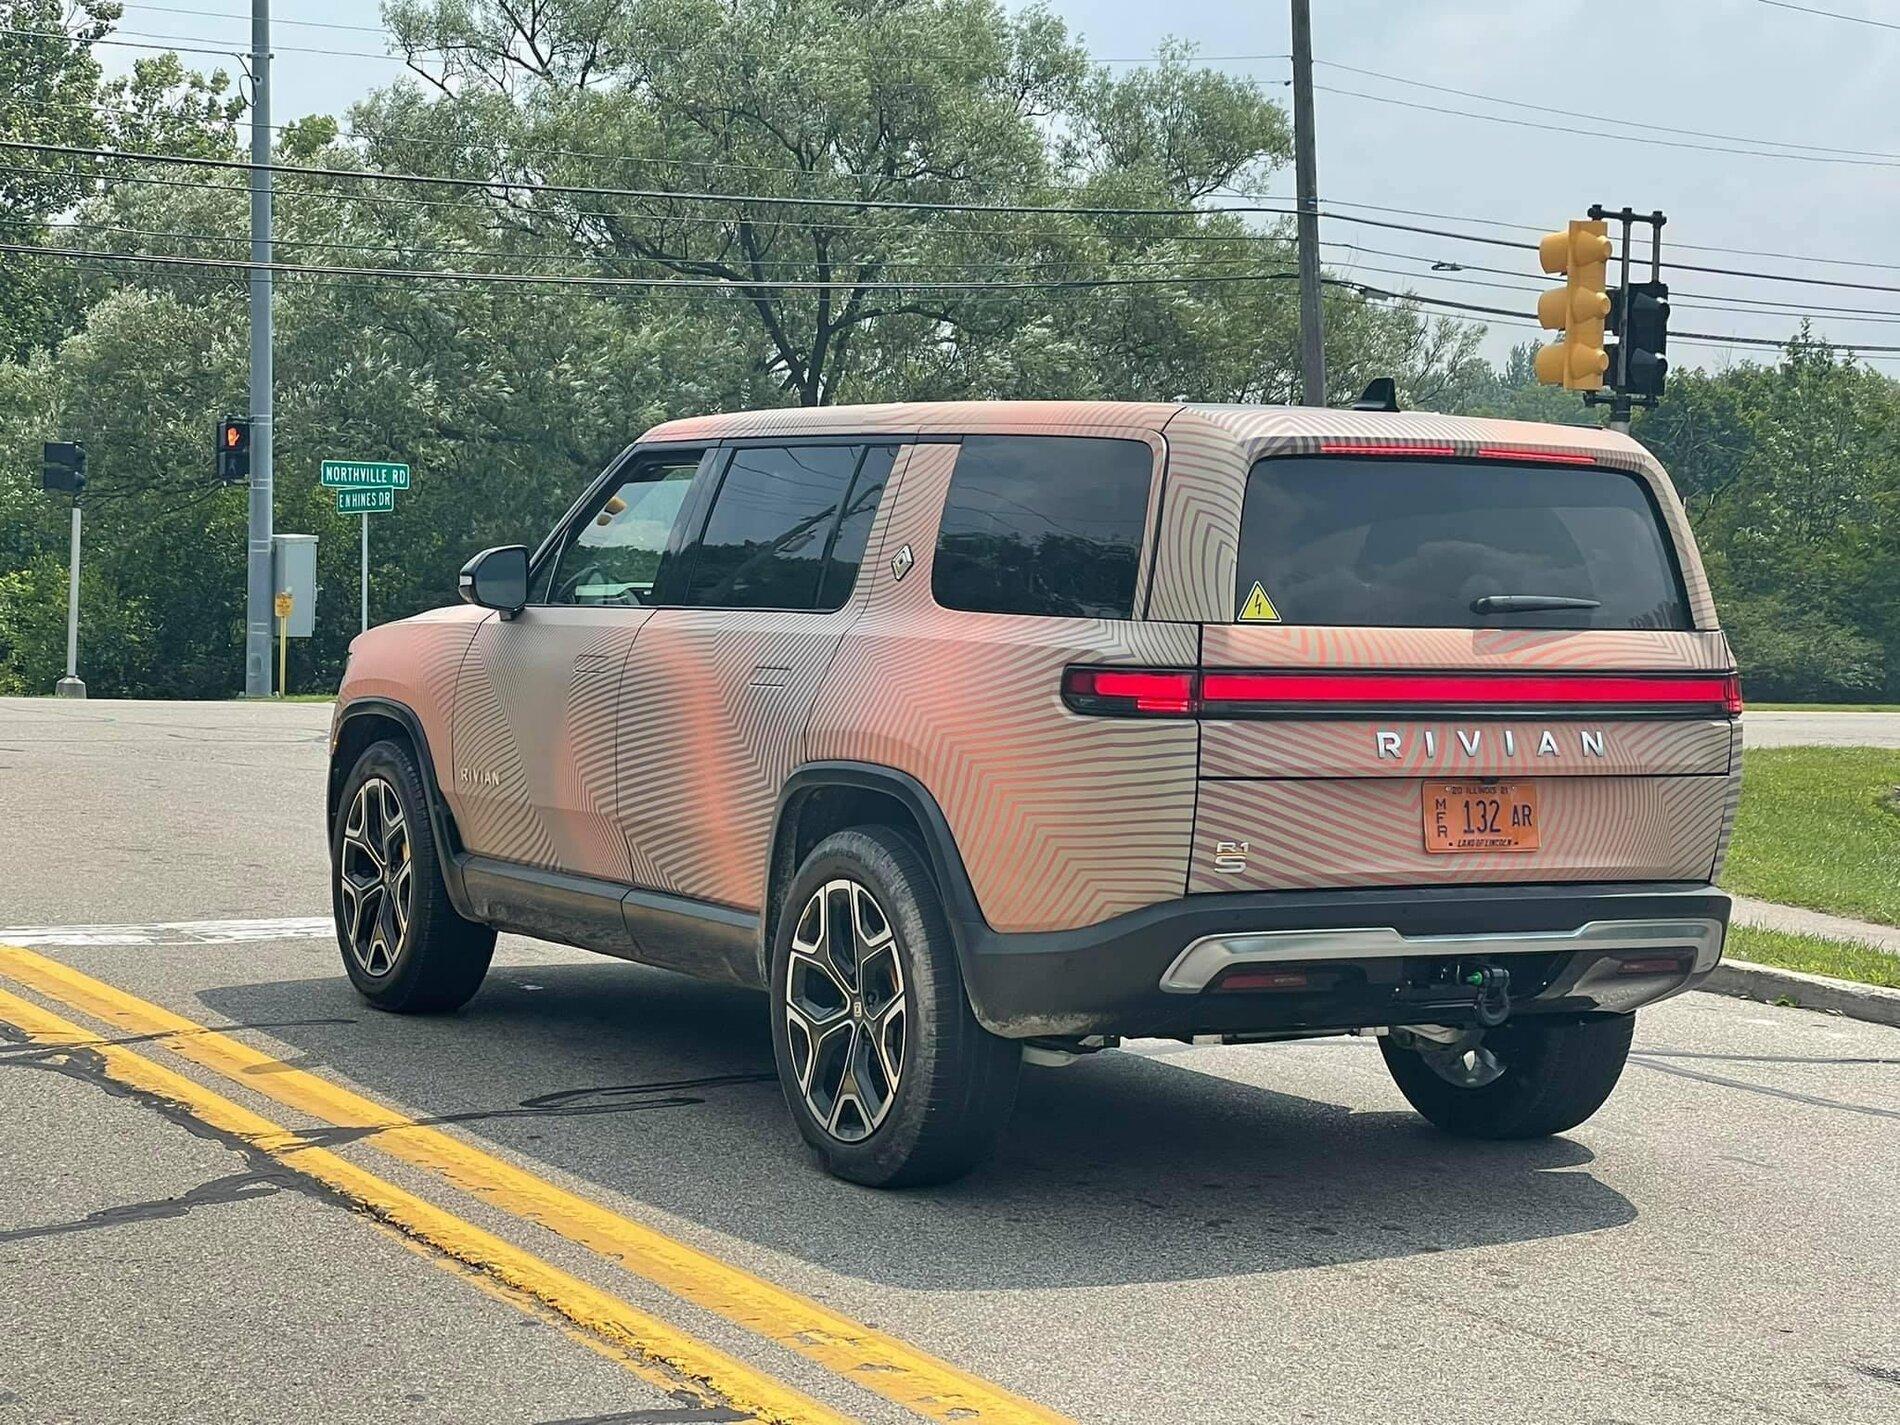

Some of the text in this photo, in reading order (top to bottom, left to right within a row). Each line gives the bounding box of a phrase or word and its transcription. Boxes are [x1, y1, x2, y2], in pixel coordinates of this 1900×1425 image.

[326, 466, 406, 484] NORTHVILLE RD
[339, 492, 391, 508] E N HINES DR
[1376, 730, 1604, 758] RIVIAN
[460, 768, 500, 786] RIVIAN
[1466, 786, 1497, 795] ILLINOIS
[1463, 800, 1501, 833] 132
[1511, 804, 1532, 827] AR
[1216, 842, 1249, 853] R1
[1214, 855, 1247, 874] S
